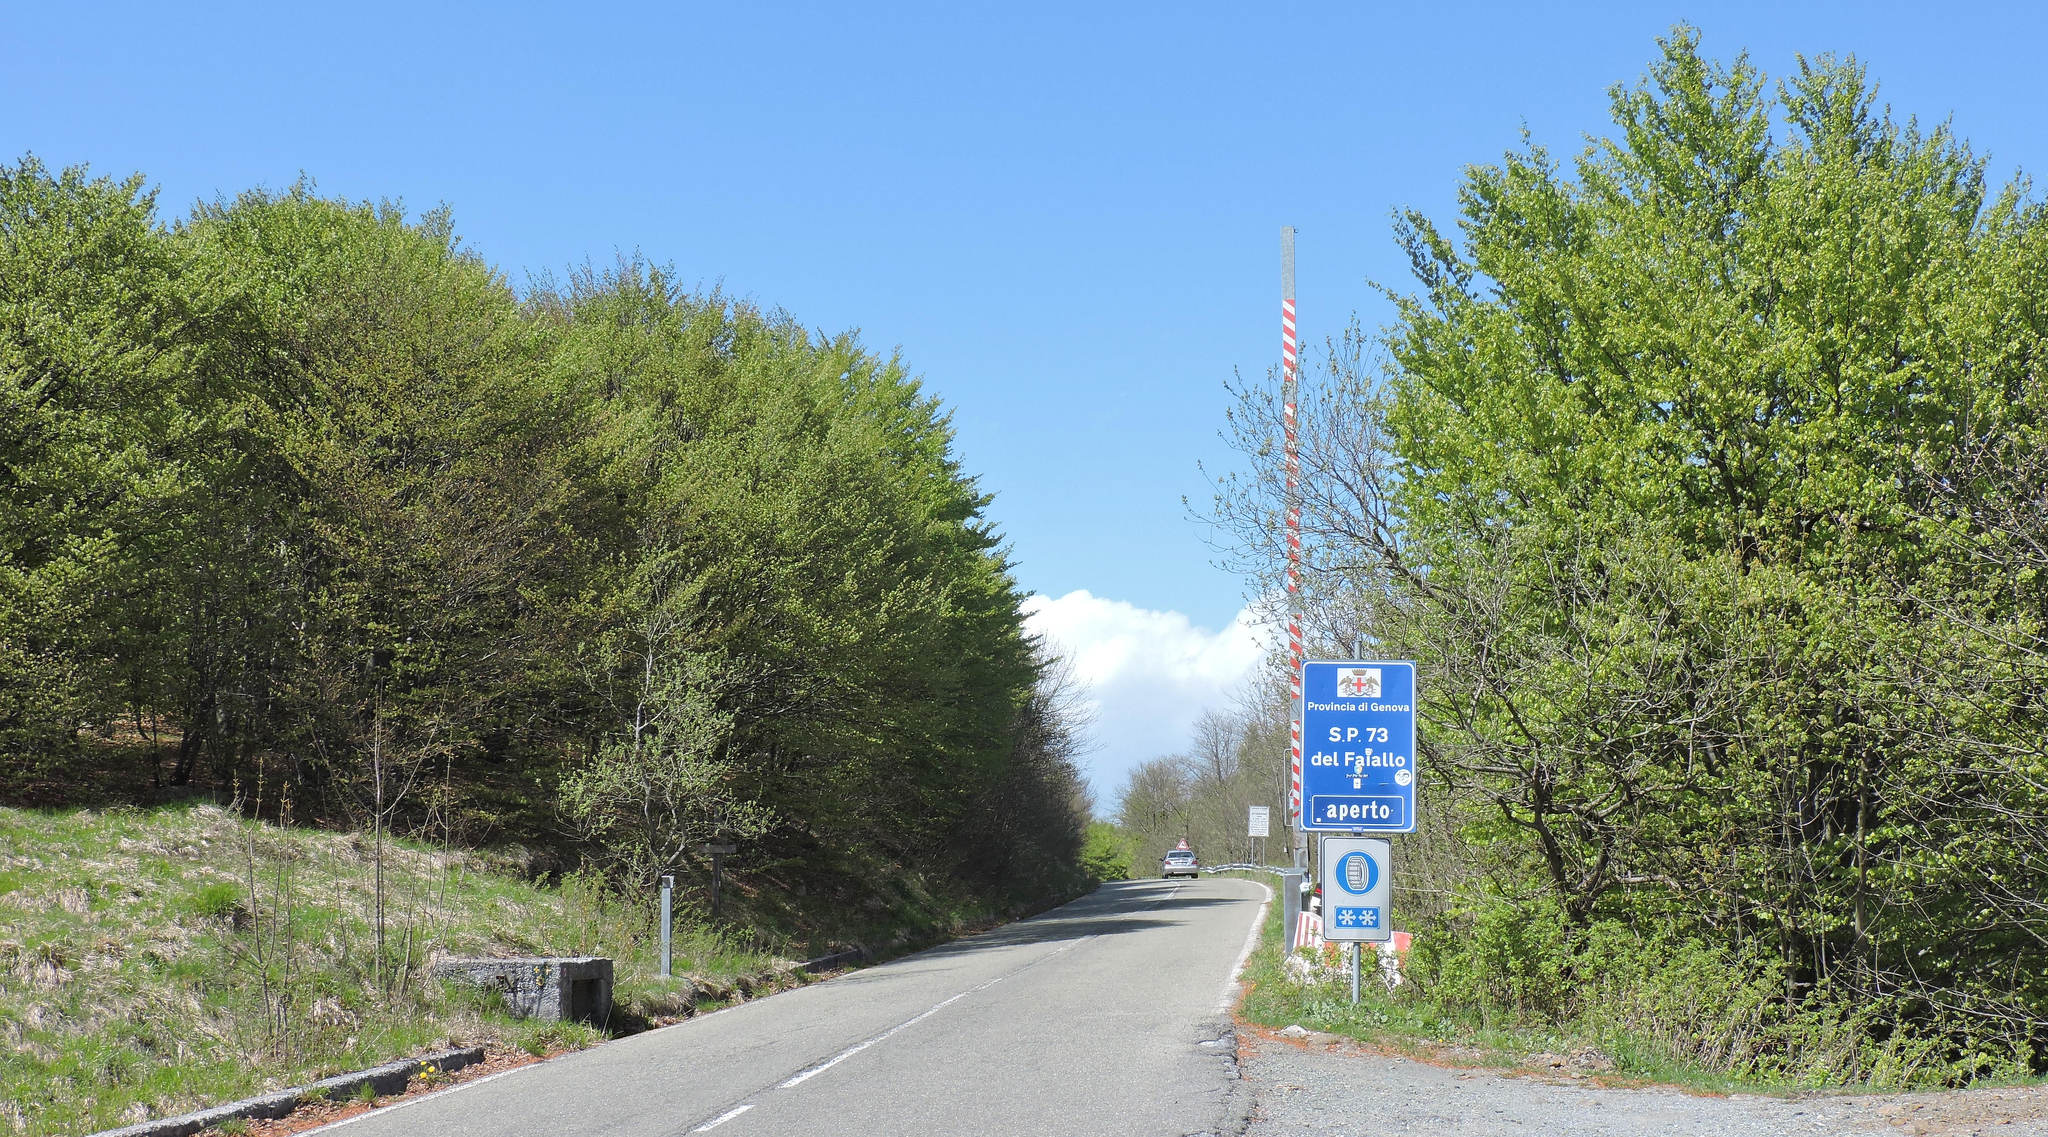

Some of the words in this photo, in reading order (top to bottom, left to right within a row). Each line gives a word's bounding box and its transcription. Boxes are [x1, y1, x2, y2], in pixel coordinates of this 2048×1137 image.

[1307, 701, 1356, 712] Provincia
[1357, 702, 1368, 712] di
[1370, 702, 1410, 712] Genova
[1328, 726, 1362, 743] S.P.
[1365, 727, 1389, 743] 73
[1310, 751, 1340, 767] del
[1344, 751, 1406, 768] Faiallo
[1326, 800, 1390, 821] aperto
